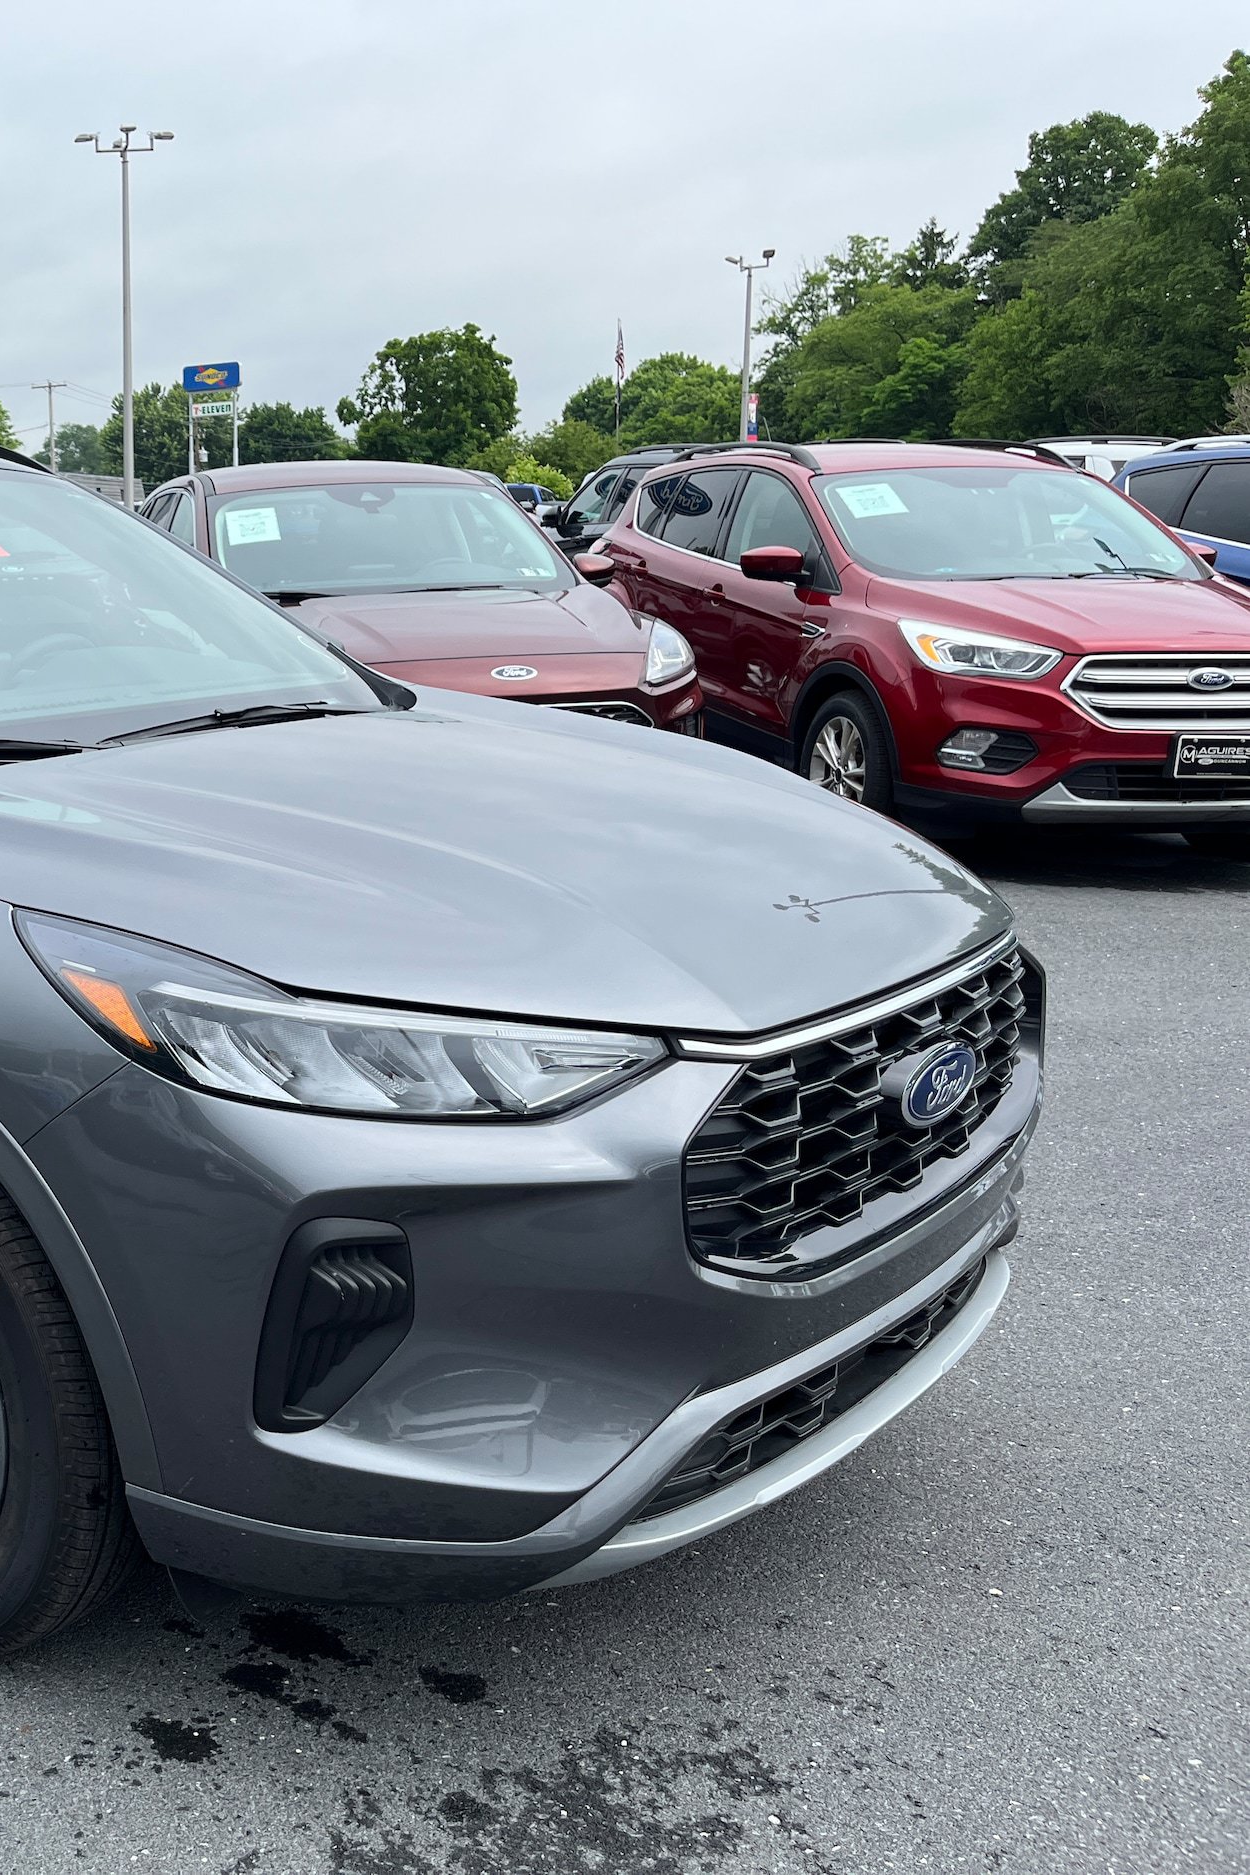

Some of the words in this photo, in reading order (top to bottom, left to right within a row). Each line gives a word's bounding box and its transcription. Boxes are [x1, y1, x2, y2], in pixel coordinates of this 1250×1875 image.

[502, 667, 528, 677] Ford
[1200, 673, 1225, 684] Ford
[927, 1060, 967, 1111] Ford
